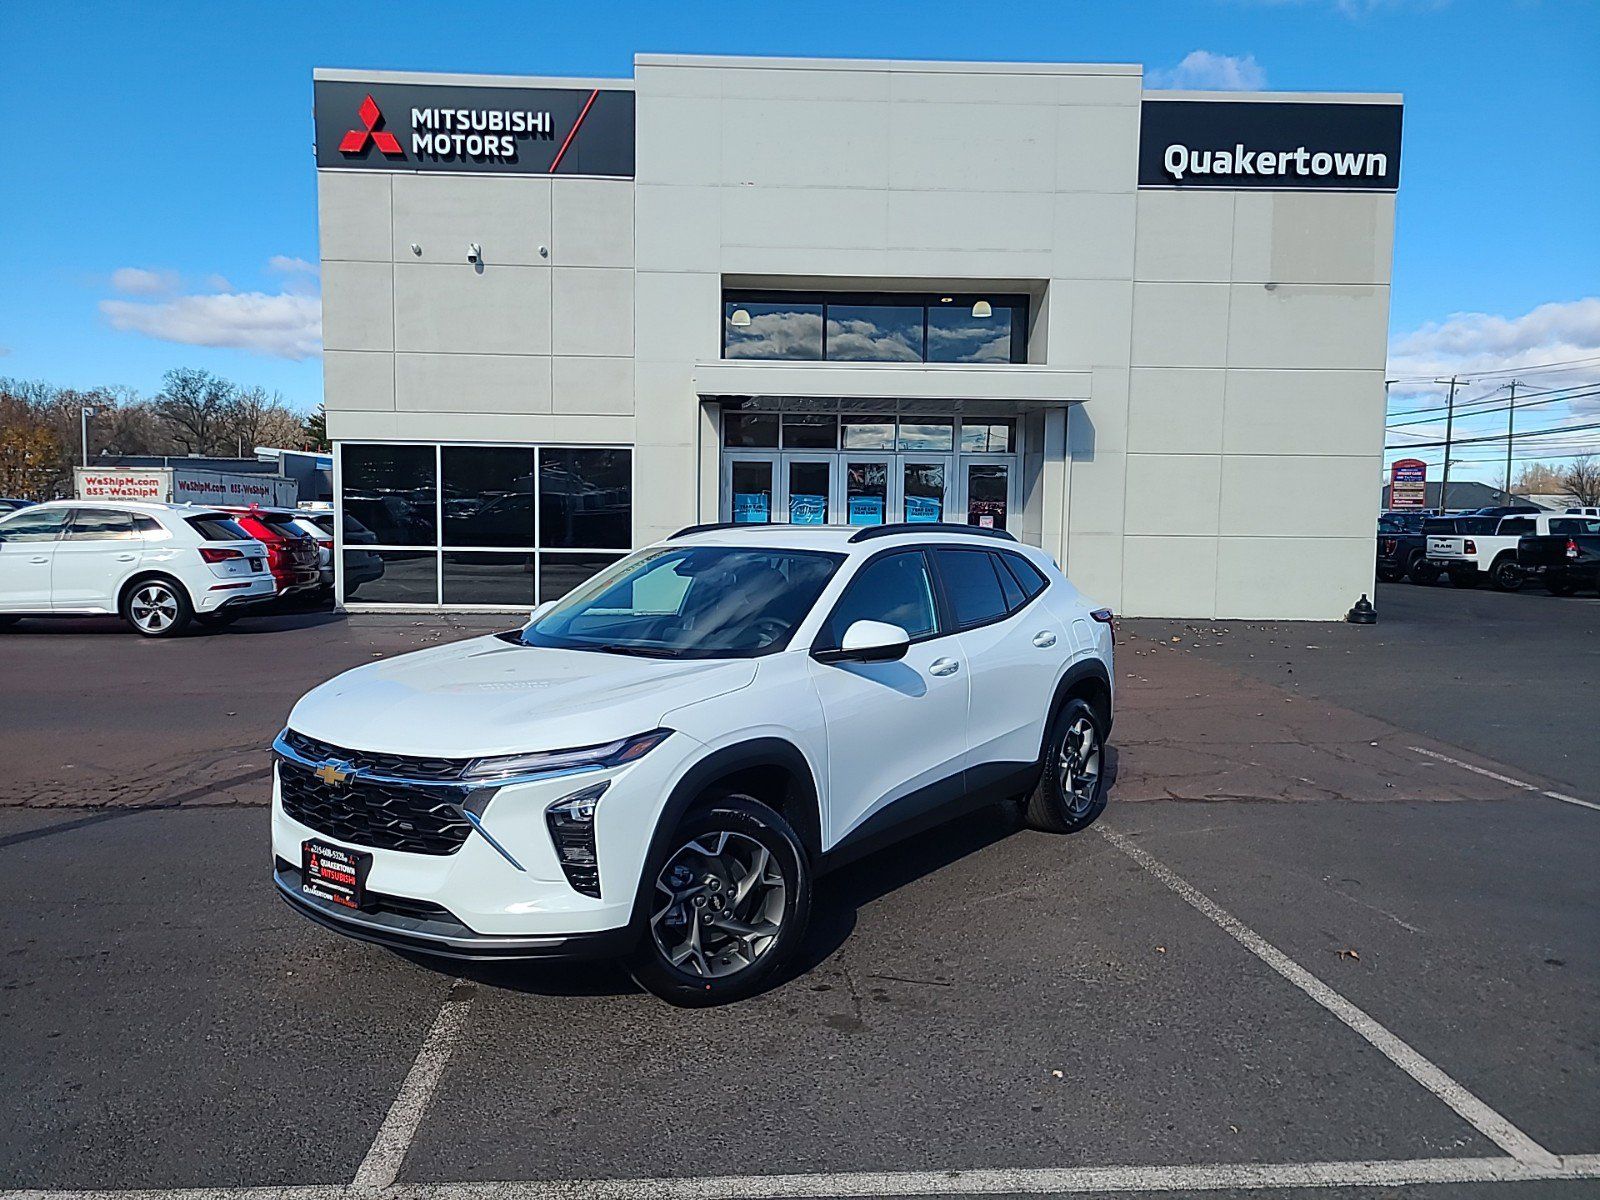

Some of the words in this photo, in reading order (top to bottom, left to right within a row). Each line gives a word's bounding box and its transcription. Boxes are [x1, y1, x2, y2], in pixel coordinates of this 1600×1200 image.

[411, 108, 550, 132] MITSUBISHI
[412, 133, 514, 156] MOTORS
[1164, 144, 1387, 179] Quakertown
[84, 477, 159, 487] WeShipM.com
[178, 480, 227, 494] WeShipM.com
[230, 483, 270, 497] 855-WeShipM
[85, 487, 159, 498] 855-WeShipM
[320, 858, 356, 876] QUAKERTOWN
[320, 867, 356, 885] MITSUBISHI
